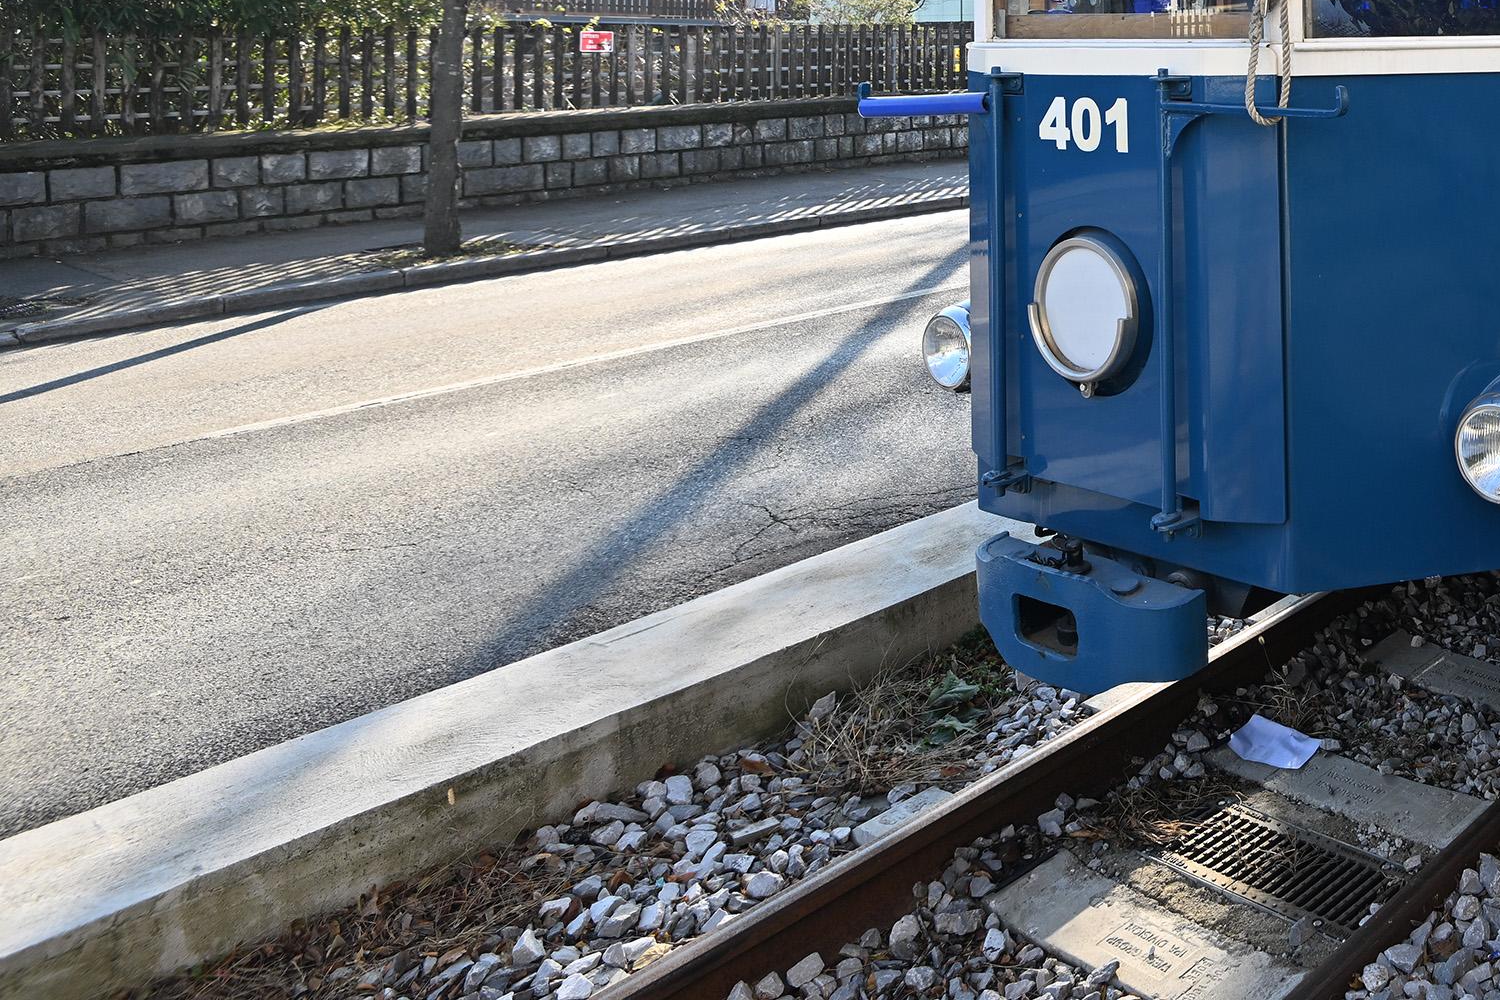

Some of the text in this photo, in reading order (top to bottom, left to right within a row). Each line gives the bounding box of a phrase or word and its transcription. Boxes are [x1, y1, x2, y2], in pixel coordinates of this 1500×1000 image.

[1039, 96, 1128, 153] 401
[1105, 936, 1143, 958] GROUP
[1124, 922, 1188, 958] IPA DIVISION
